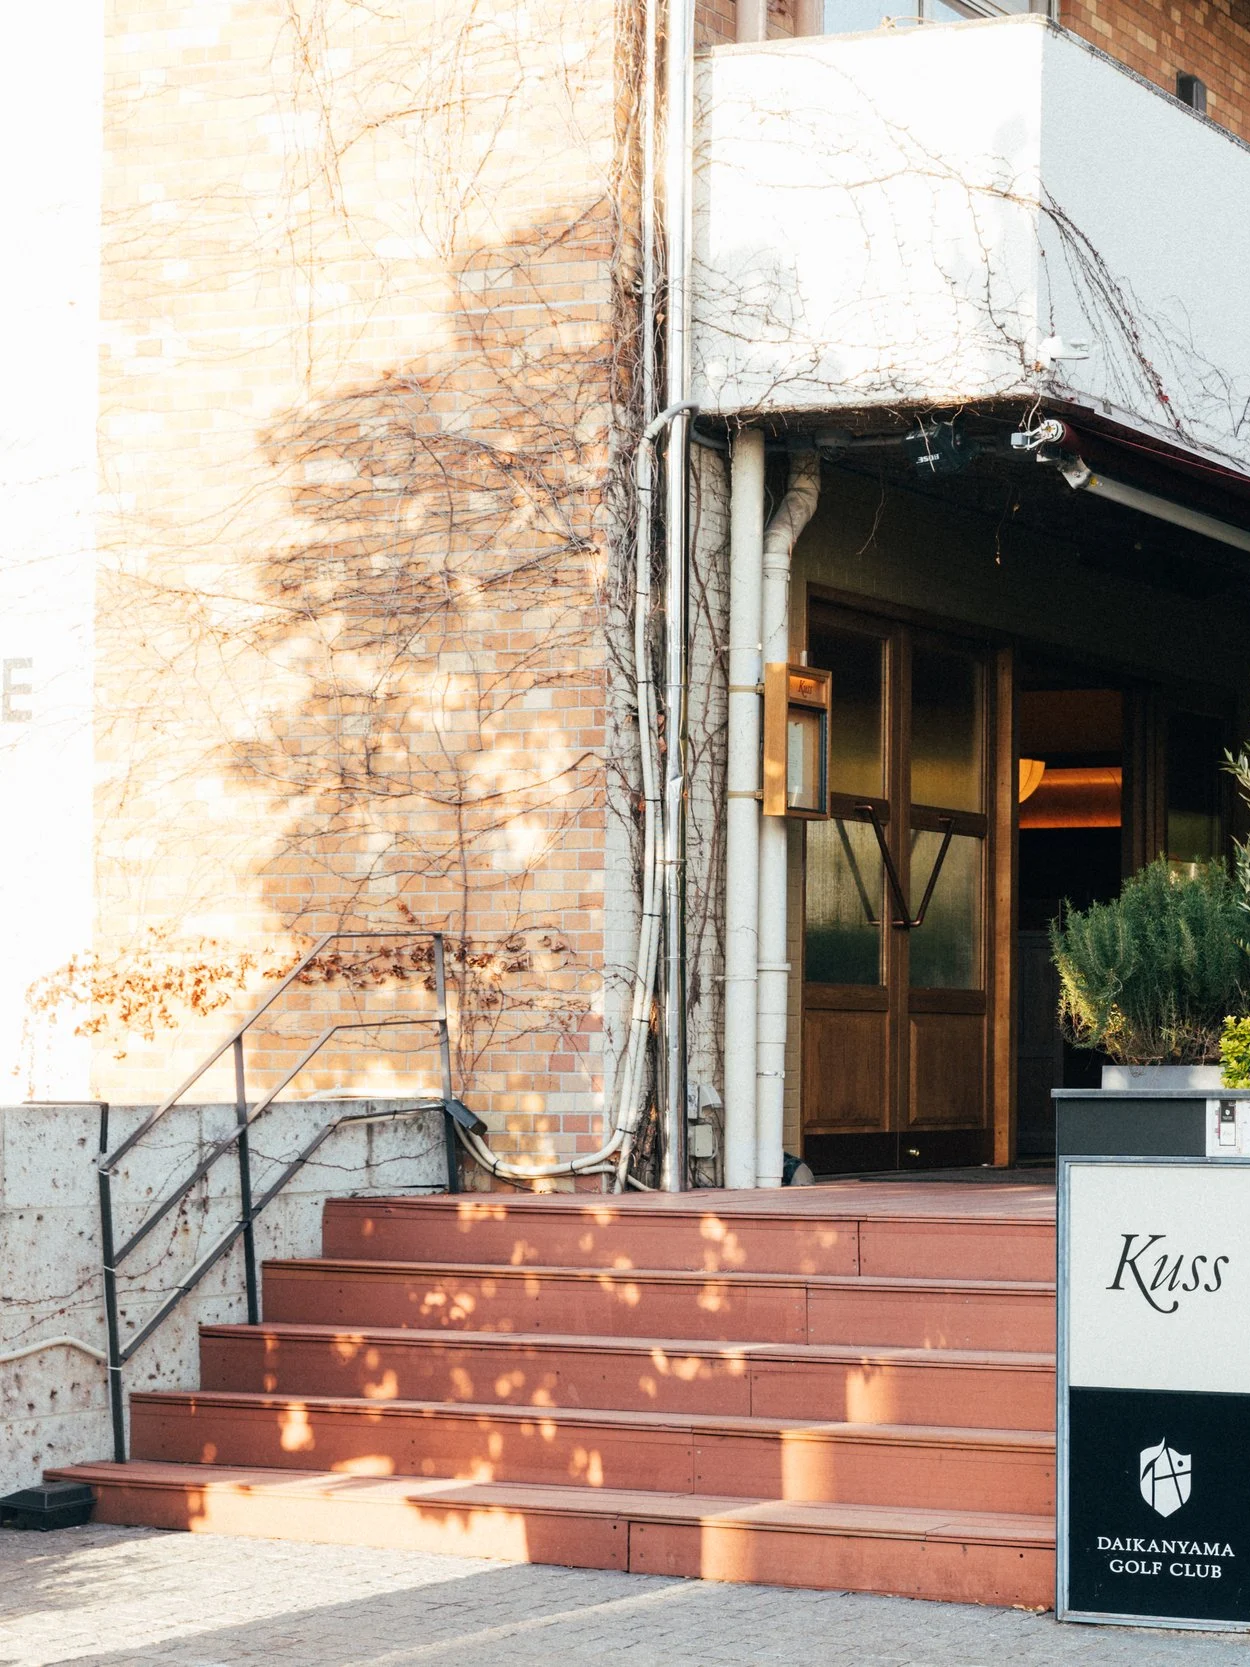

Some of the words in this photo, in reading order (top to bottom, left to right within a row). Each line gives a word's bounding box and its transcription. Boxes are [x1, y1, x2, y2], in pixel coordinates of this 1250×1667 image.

[916, 453, 941, 464] BOSE
[2, 657, 33, 722] E
[1105, 1233, 1230, 1314] Kuss
[1097, 1536, 1236, 1557] DAIKANYAMA
[1109, 1559, 1163, 1575] GOLF
[1169, 1562, 1222, 1579] CLUB
